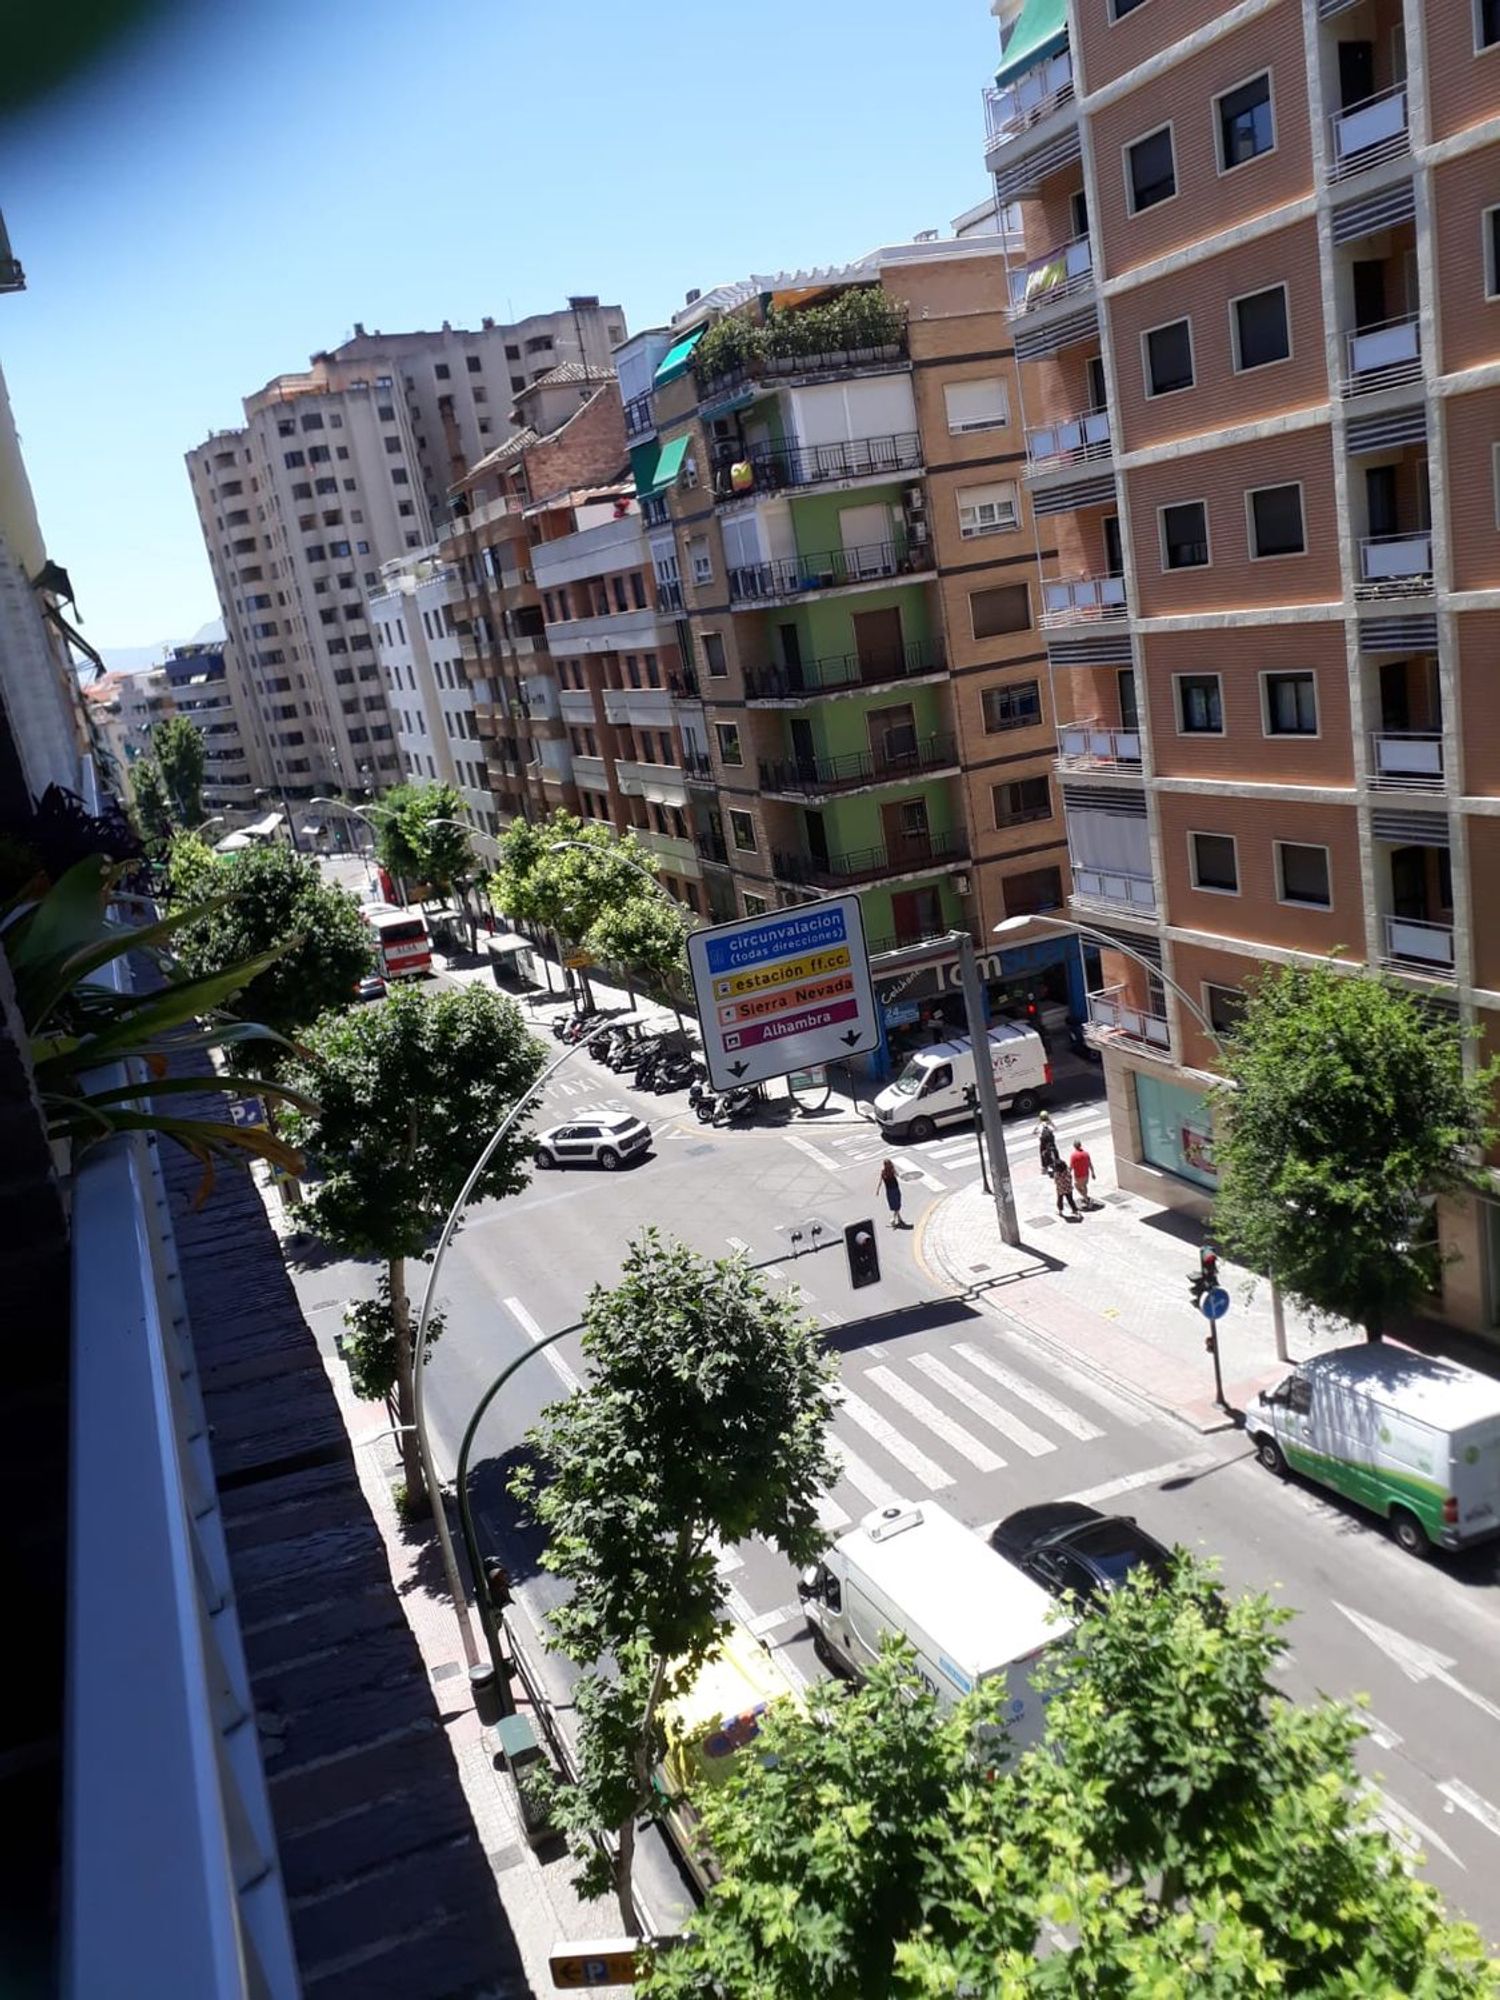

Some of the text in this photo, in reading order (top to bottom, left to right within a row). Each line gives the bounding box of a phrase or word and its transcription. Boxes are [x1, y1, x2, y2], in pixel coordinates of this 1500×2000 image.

[730, 927, 843, 965] (todas direcciones)
[736, 965, 803, 990] estación
[741, 980, 852, 1016] Sierra Nevada
[763, 1012, 831, 1038] Alhambra
